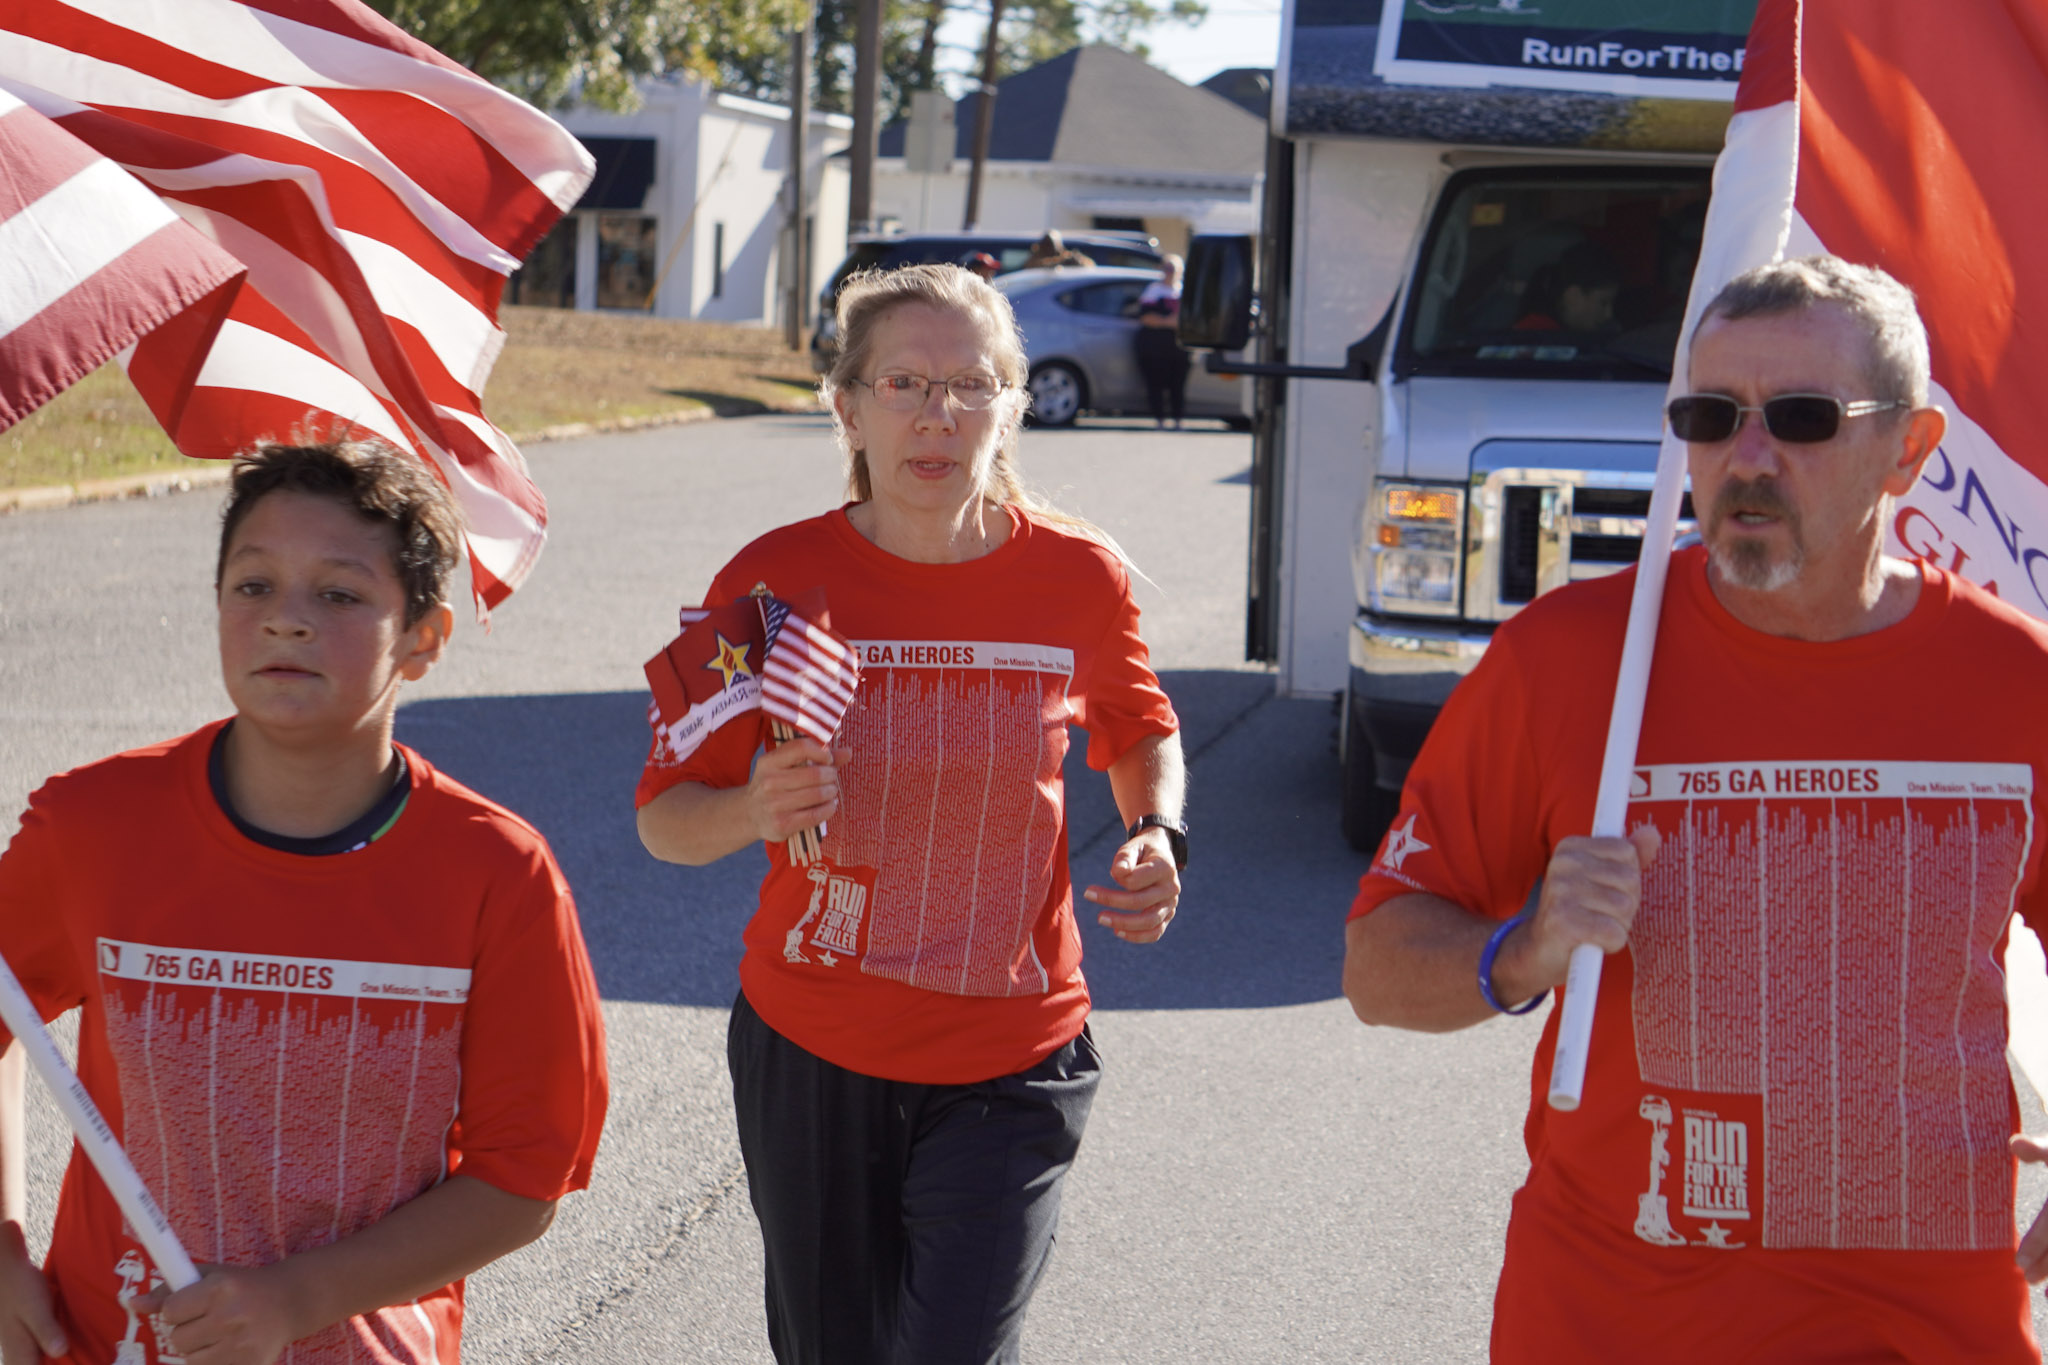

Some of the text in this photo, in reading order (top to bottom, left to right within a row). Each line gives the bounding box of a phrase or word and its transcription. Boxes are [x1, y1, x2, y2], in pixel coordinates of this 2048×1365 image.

[867, 645, 895, 664] GA
[900, 646, 975, 665] HEROES
[1678, 771, 1721, 794] 765
[1728, 769, 1767, 793] GA
[1774, 768, 1880, 793] HEROES
[1907, 781, 1927, 793] One
[1929, 781, 1968, 793] Mission.
[827, 878, 866, 920] RUN
[821, 908, 861, 936] FOR THE
[814, 922, 857, 951] FALLEN
[144, 953, 181, 978] 765
[188, 956, 223, 982] GA
[231, 959, 334, 990] HEROES
[1684, 1116, 1748, 1166] RUN
[1684, 1160, 1747, 1188] FOR THE
[1683, 1183, 1748, 1210] FALLEN
